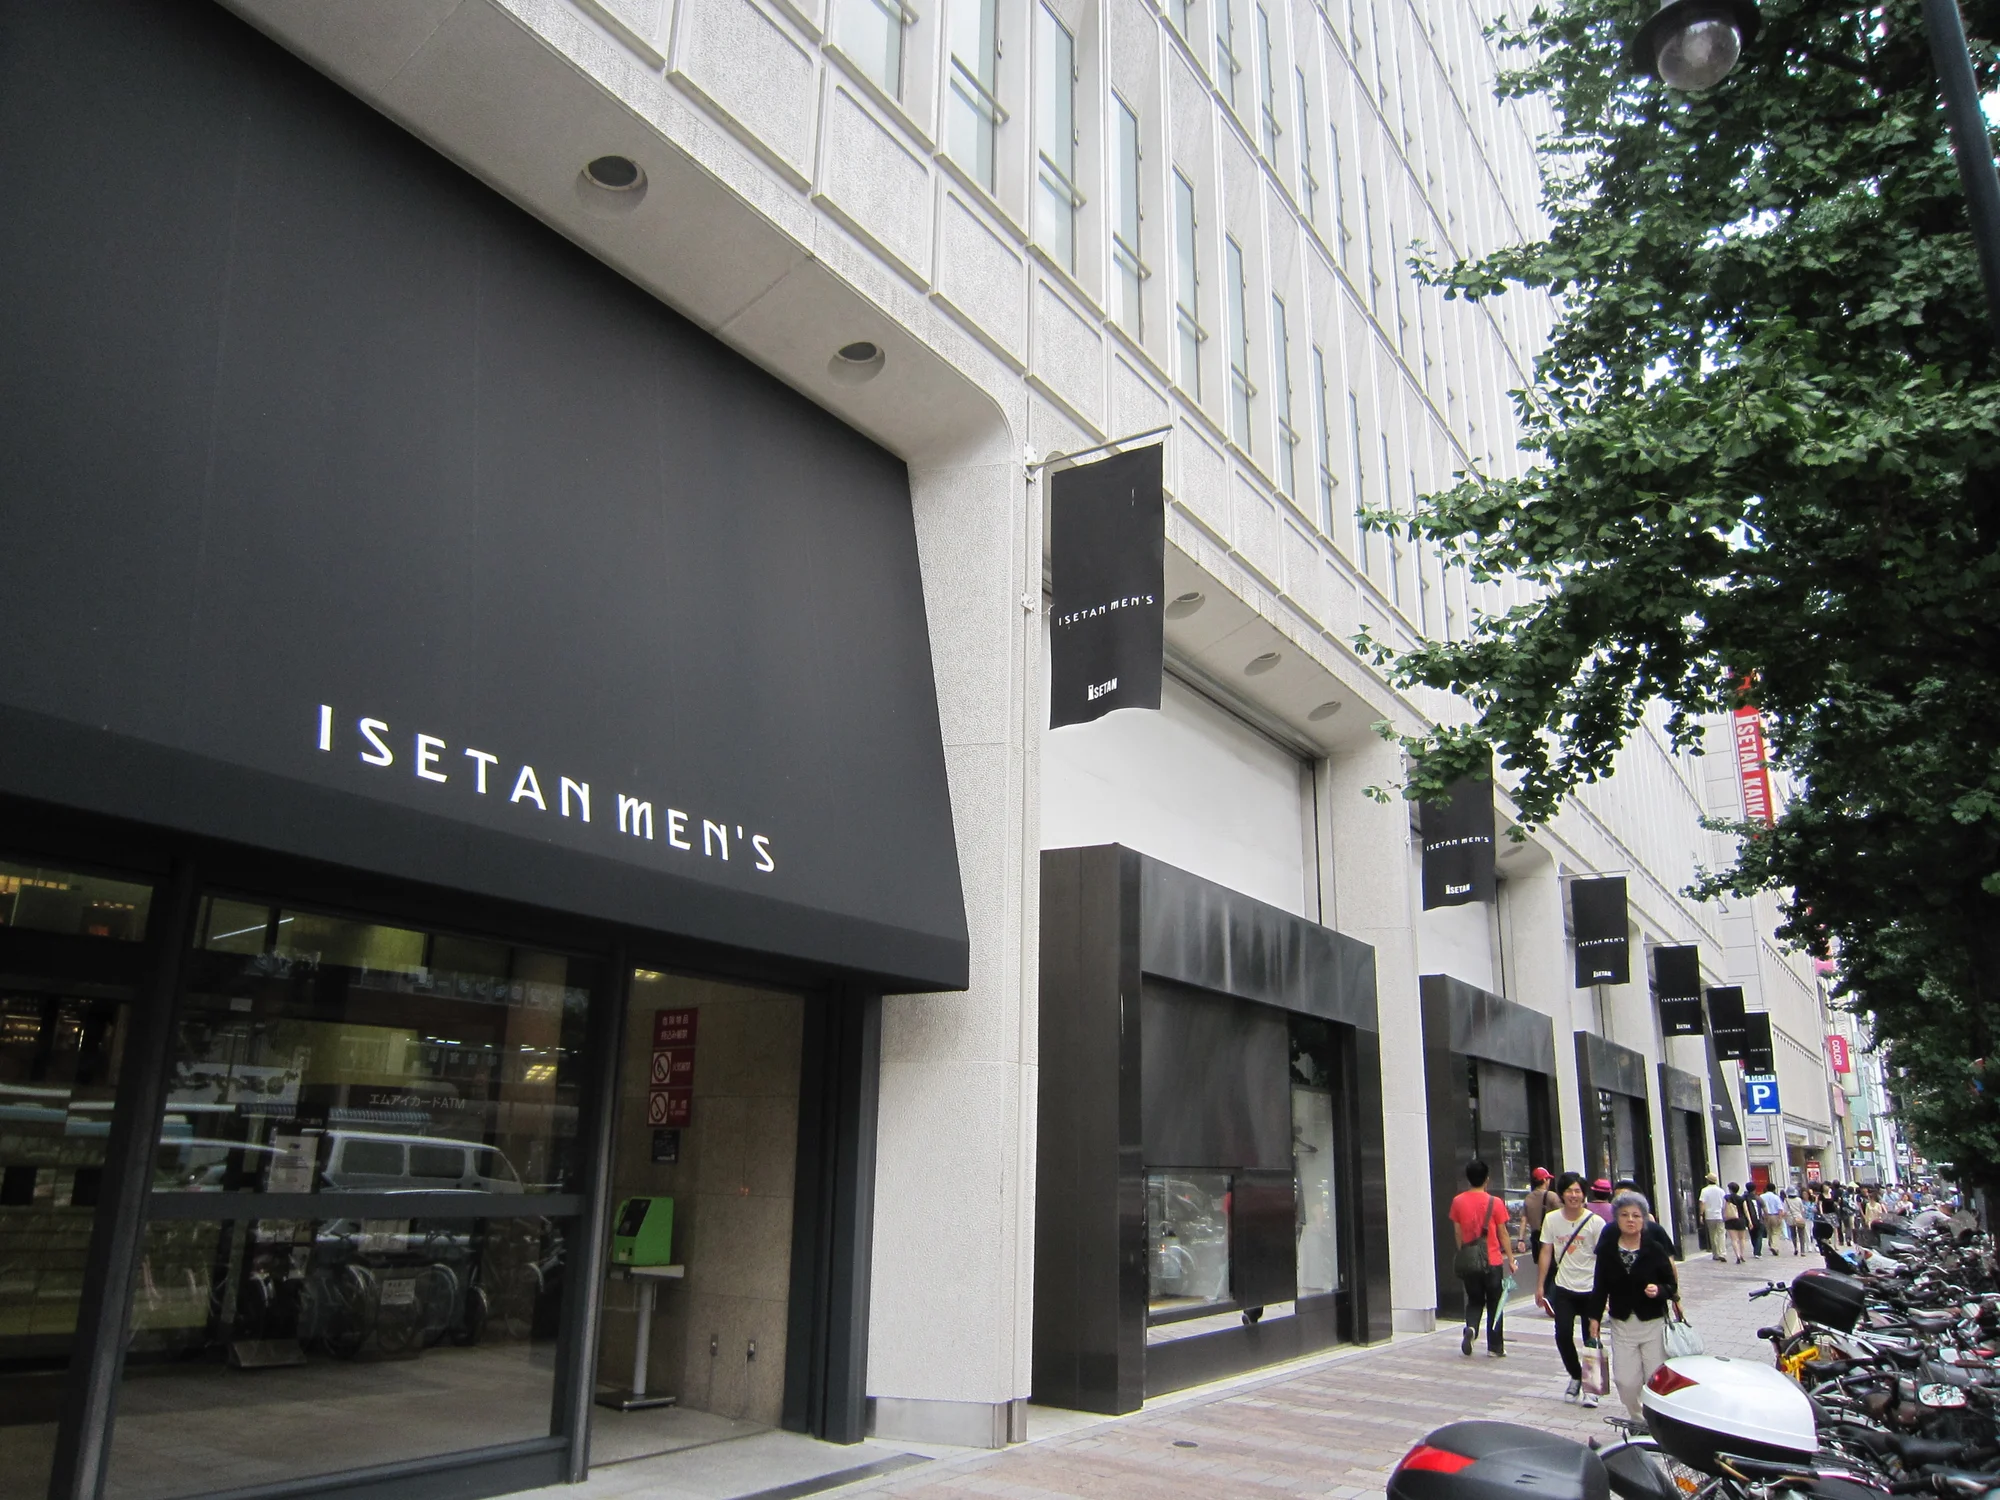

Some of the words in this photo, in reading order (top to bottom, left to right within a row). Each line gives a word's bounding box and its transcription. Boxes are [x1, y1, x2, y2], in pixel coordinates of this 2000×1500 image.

[1058, 604, 1106, 627] ISETAN
[1110, 595, 1154, 610] MEN'S
[1087, 677, 1118, 701] ISETAN
[1735, 713, 1760, 773] ISETAN
[318, 704, 591, 823] ISETAN
[617, 793, 776, 874] MEN'S
[1426, 839, 1458, 852] ISETAN
[1461, 836, 1490, 845] MEN'S
[1445, 883, 1471, 895] ISETAN
[1578, 939, 1603, 947] ISETAN
[1831, 1039, 1843, 1067] COLOR
[369, 1094, 465, 1109] エムアイカードATM
[1752, 1084, 1771, 1106] P
